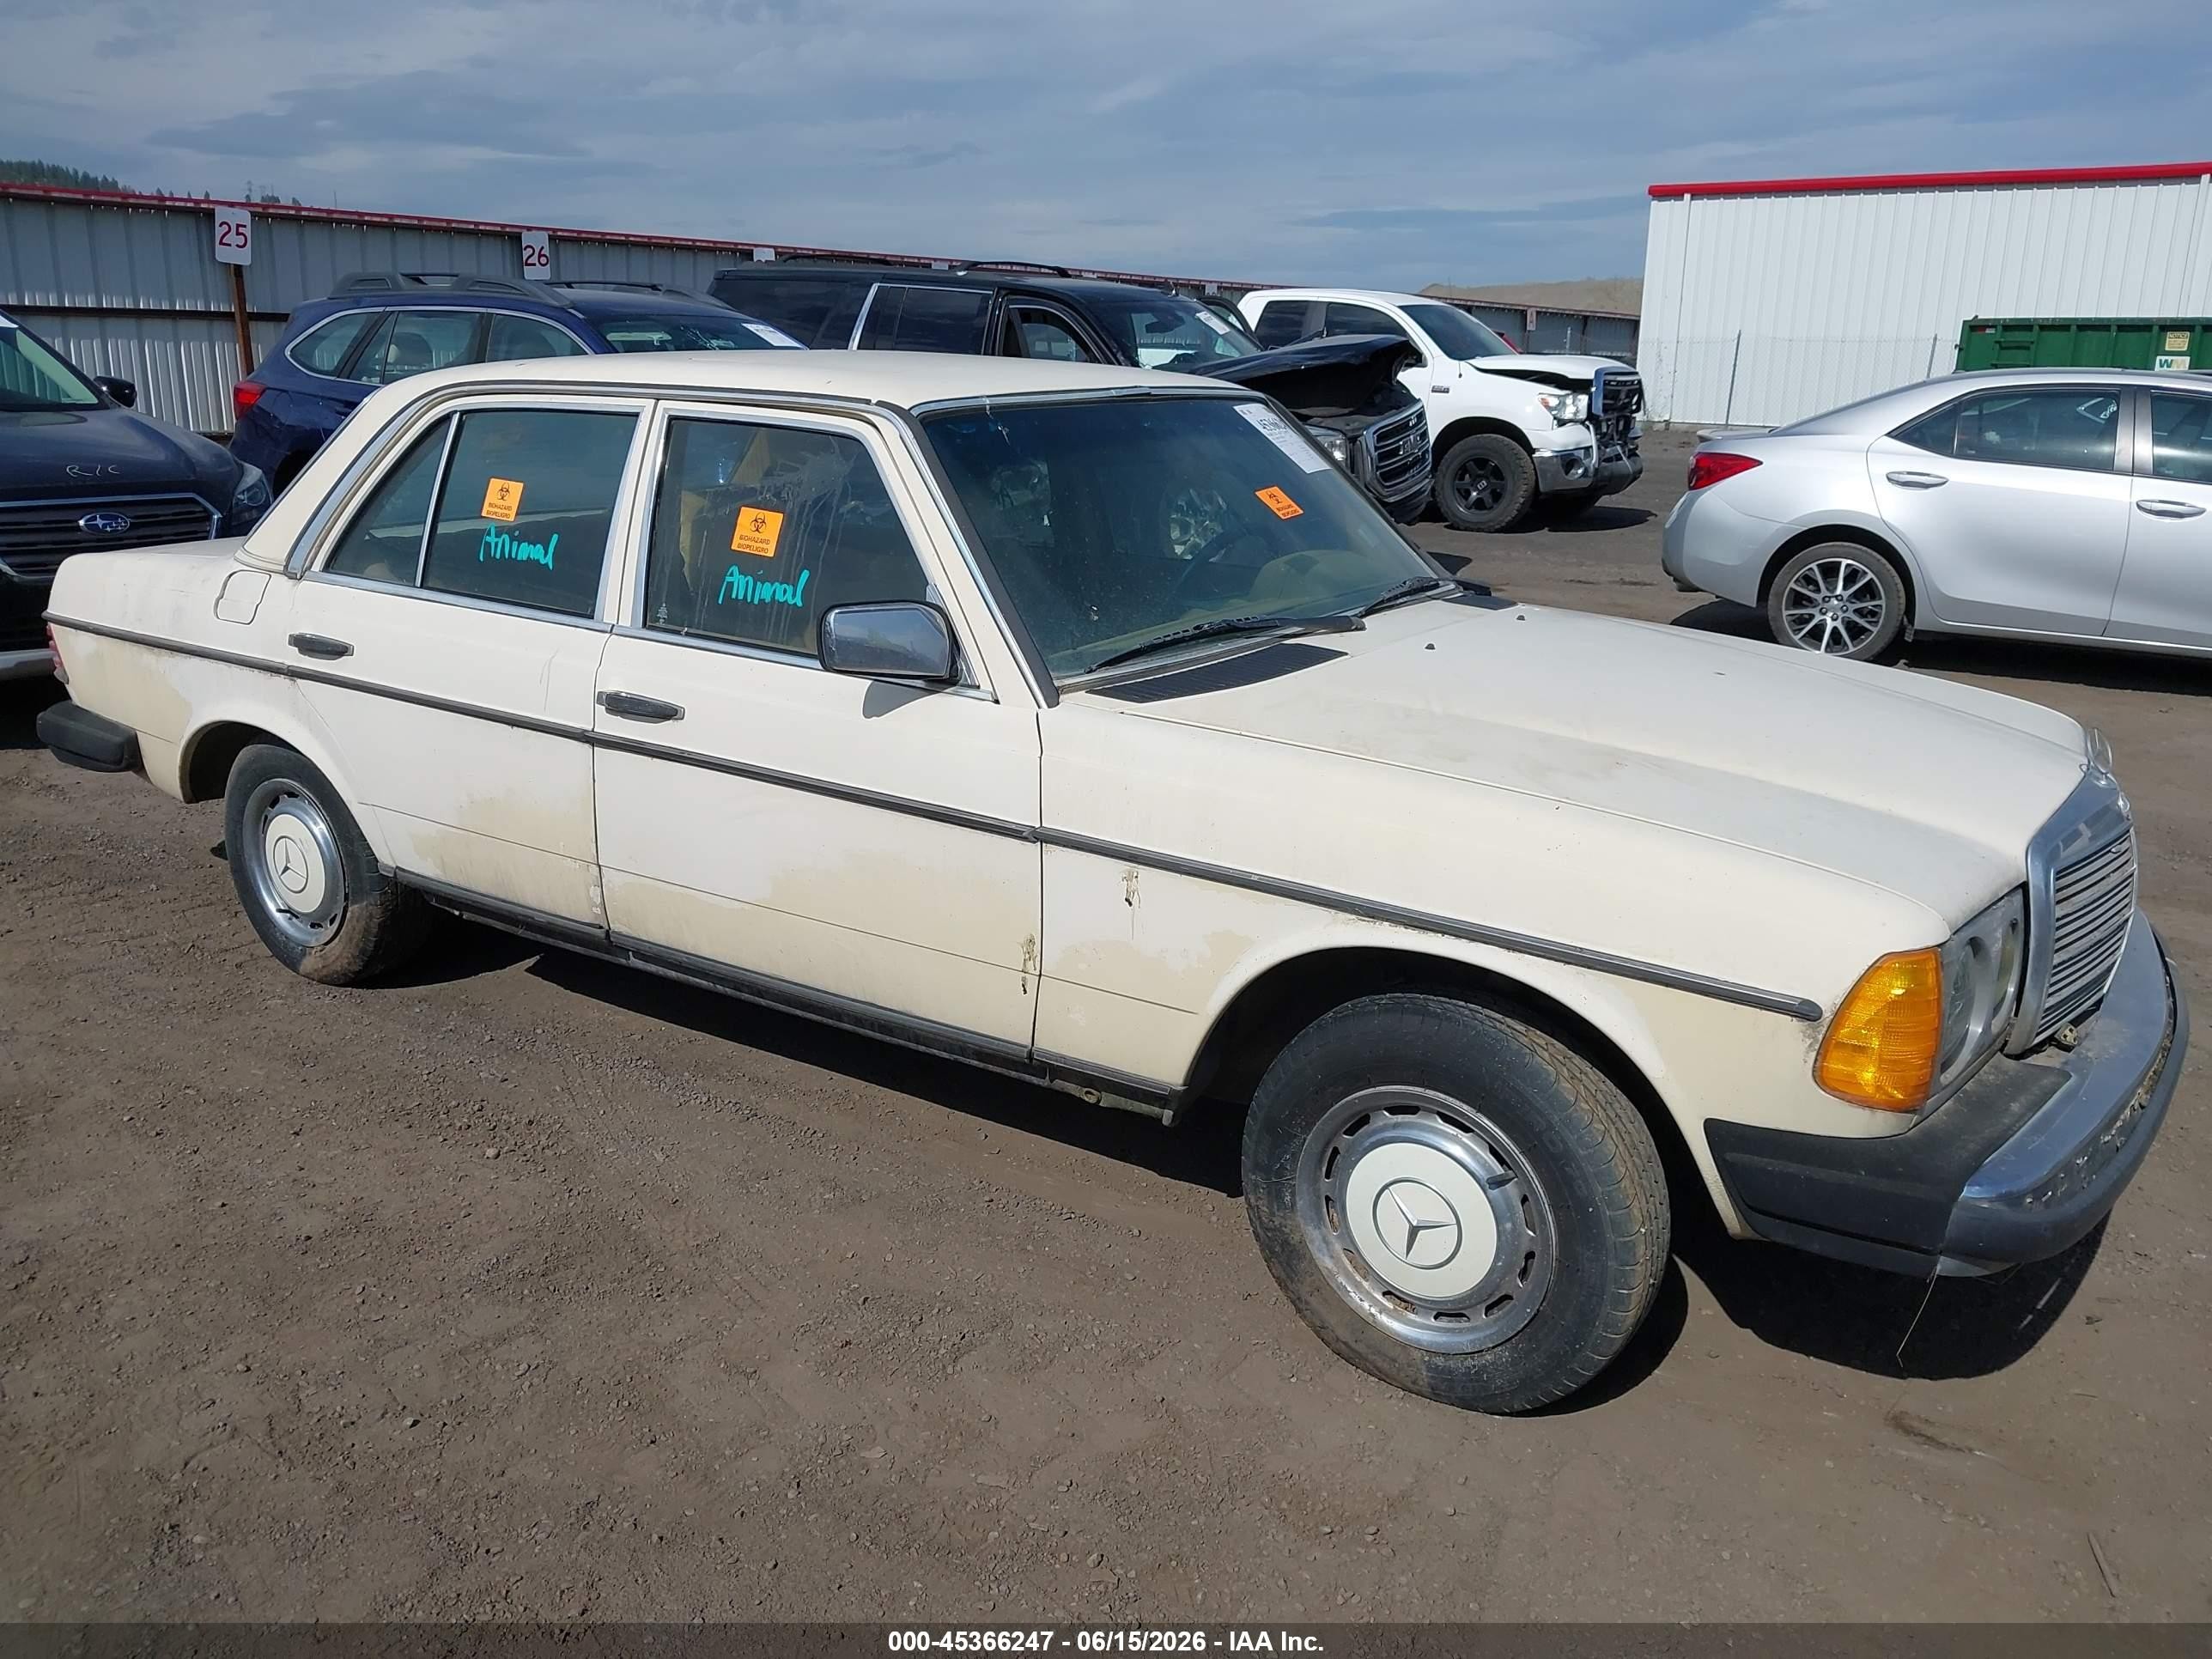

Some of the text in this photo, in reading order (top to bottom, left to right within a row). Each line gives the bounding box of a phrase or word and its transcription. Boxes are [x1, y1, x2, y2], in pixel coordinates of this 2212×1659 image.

[219, 221, 247, 248] 25
[524, 245, 549, 266] 26
[479, 522, 559, 570] Animal
[737, 542, 769, 554] BIOPELIGRO
[738, 534, 770, 545] BIOHAZARD
[718, 564, 810, 606] Animal
